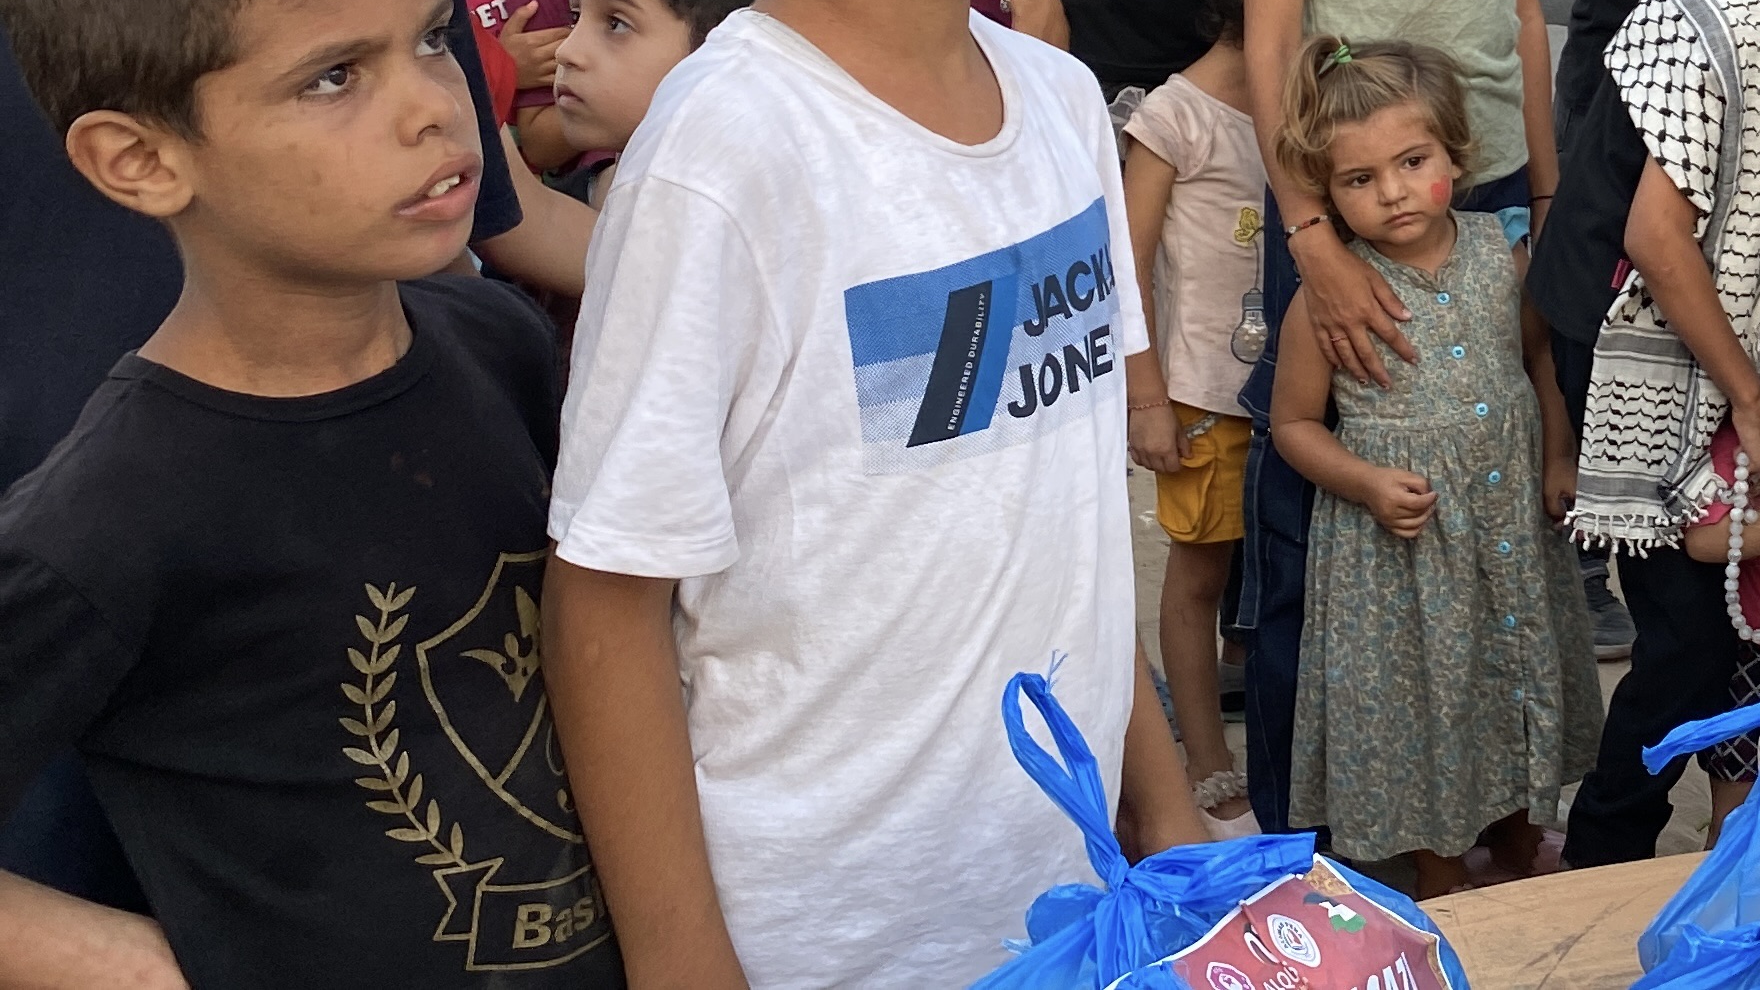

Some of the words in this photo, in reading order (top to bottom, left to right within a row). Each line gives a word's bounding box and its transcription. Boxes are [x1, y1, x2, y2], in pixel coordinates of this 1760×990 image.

[946, 361, 974, 432] ENGINEERED
[968, 292, 986, 359] DURABILITY
[1007, 323, 1117, 418] JONE
[512, 895, 598, 949] Bas
